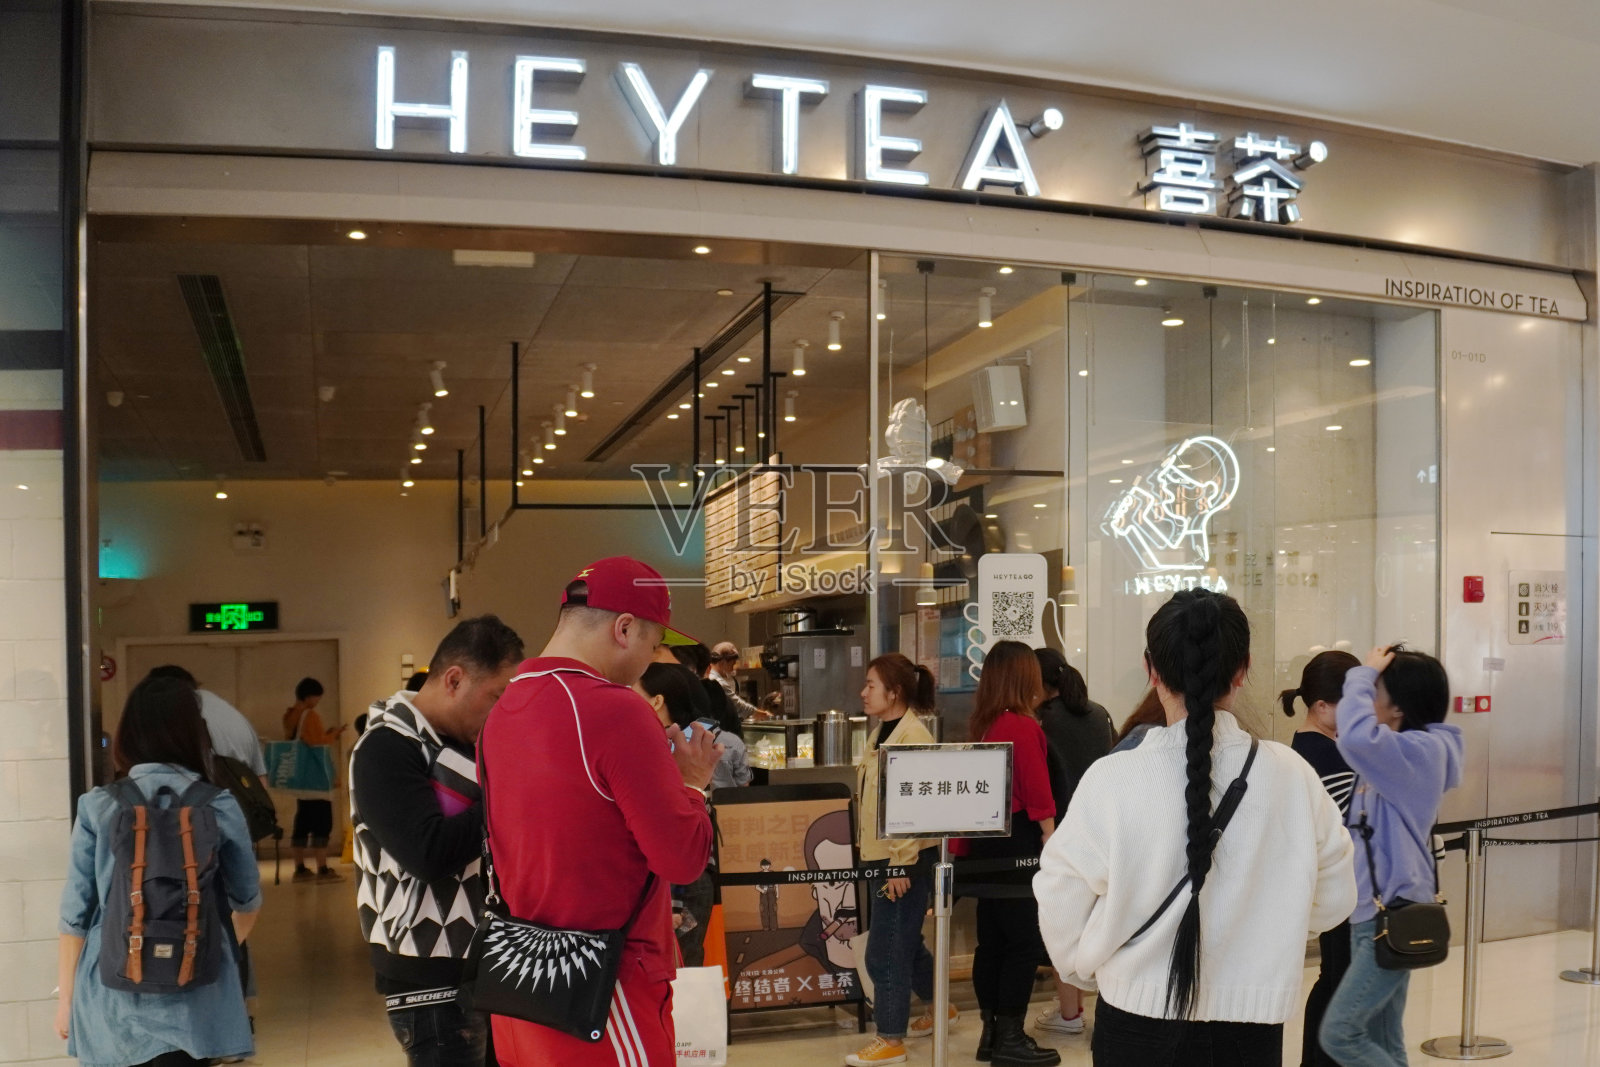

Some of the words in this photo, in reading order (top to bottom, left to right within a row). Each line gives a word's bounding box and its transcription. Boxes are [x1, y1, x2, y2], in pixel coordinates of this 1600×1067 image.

[375, 46, 1041, 197] HEYTEA
[1143, 121, 1304, 224] 喜茶
[1385, 278, 1495, 306] INSPIRATION
[1500, 293, 1524, 310] OF
[1529, 296, 1560, 315] TEA
[899, 780, 990, 797] 喜茶排队处
[1474, 816, 1520, 829] INSPIRATION
[1523, 814, 1533, 822] OF
[1535, 811, 1549, 820] TEA
[787, 870, 859, 882] INSPIRATION
[864, 869, 880, 879] OF
[886, 868, 907, 877] TEA
[735, 977, 790, 997] 终结者
[817, 971, 854, 990] 喜茶
[822, 989, 850, 997] HEYTEA
